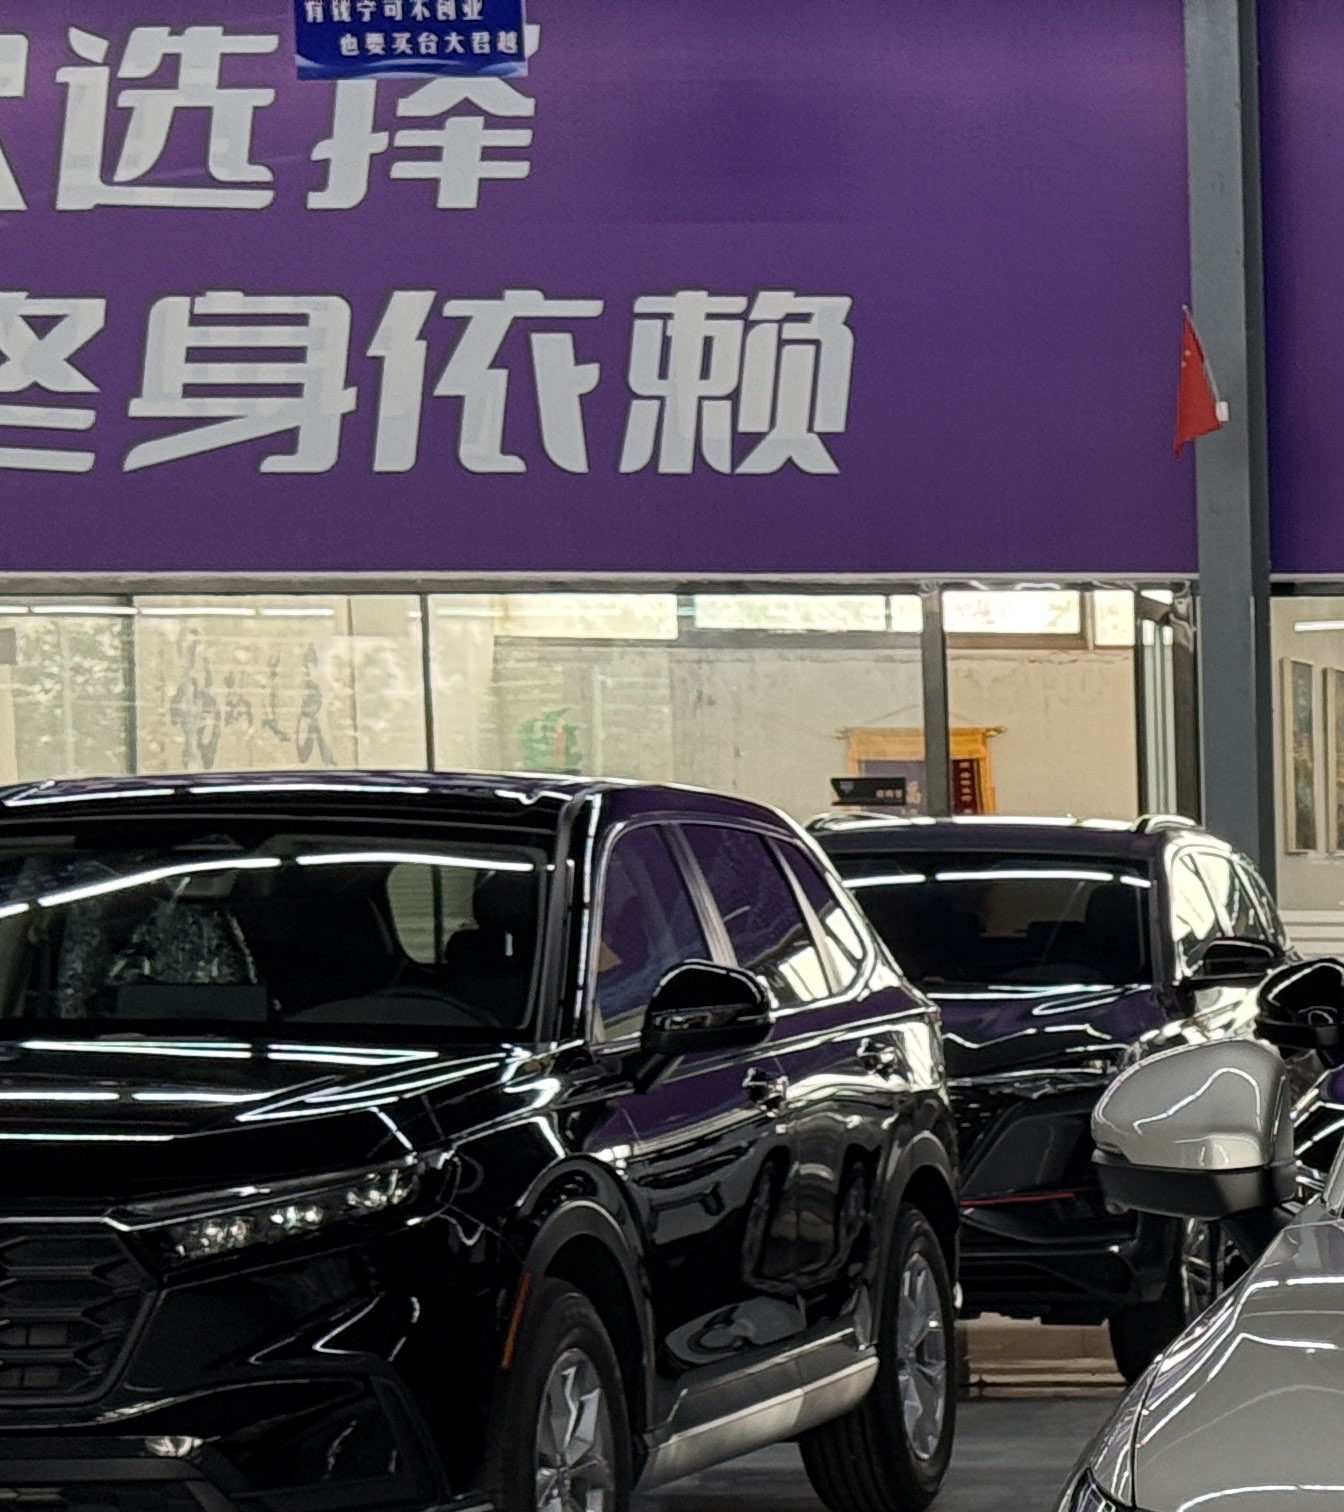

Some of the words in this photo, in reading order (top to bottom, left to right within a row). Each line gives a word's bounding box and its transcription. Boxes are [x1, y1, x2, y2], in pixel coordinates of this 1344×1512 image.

[340, 30, 520, 57] 也要买台大君越
[0, 26, 540, 210] 选择
